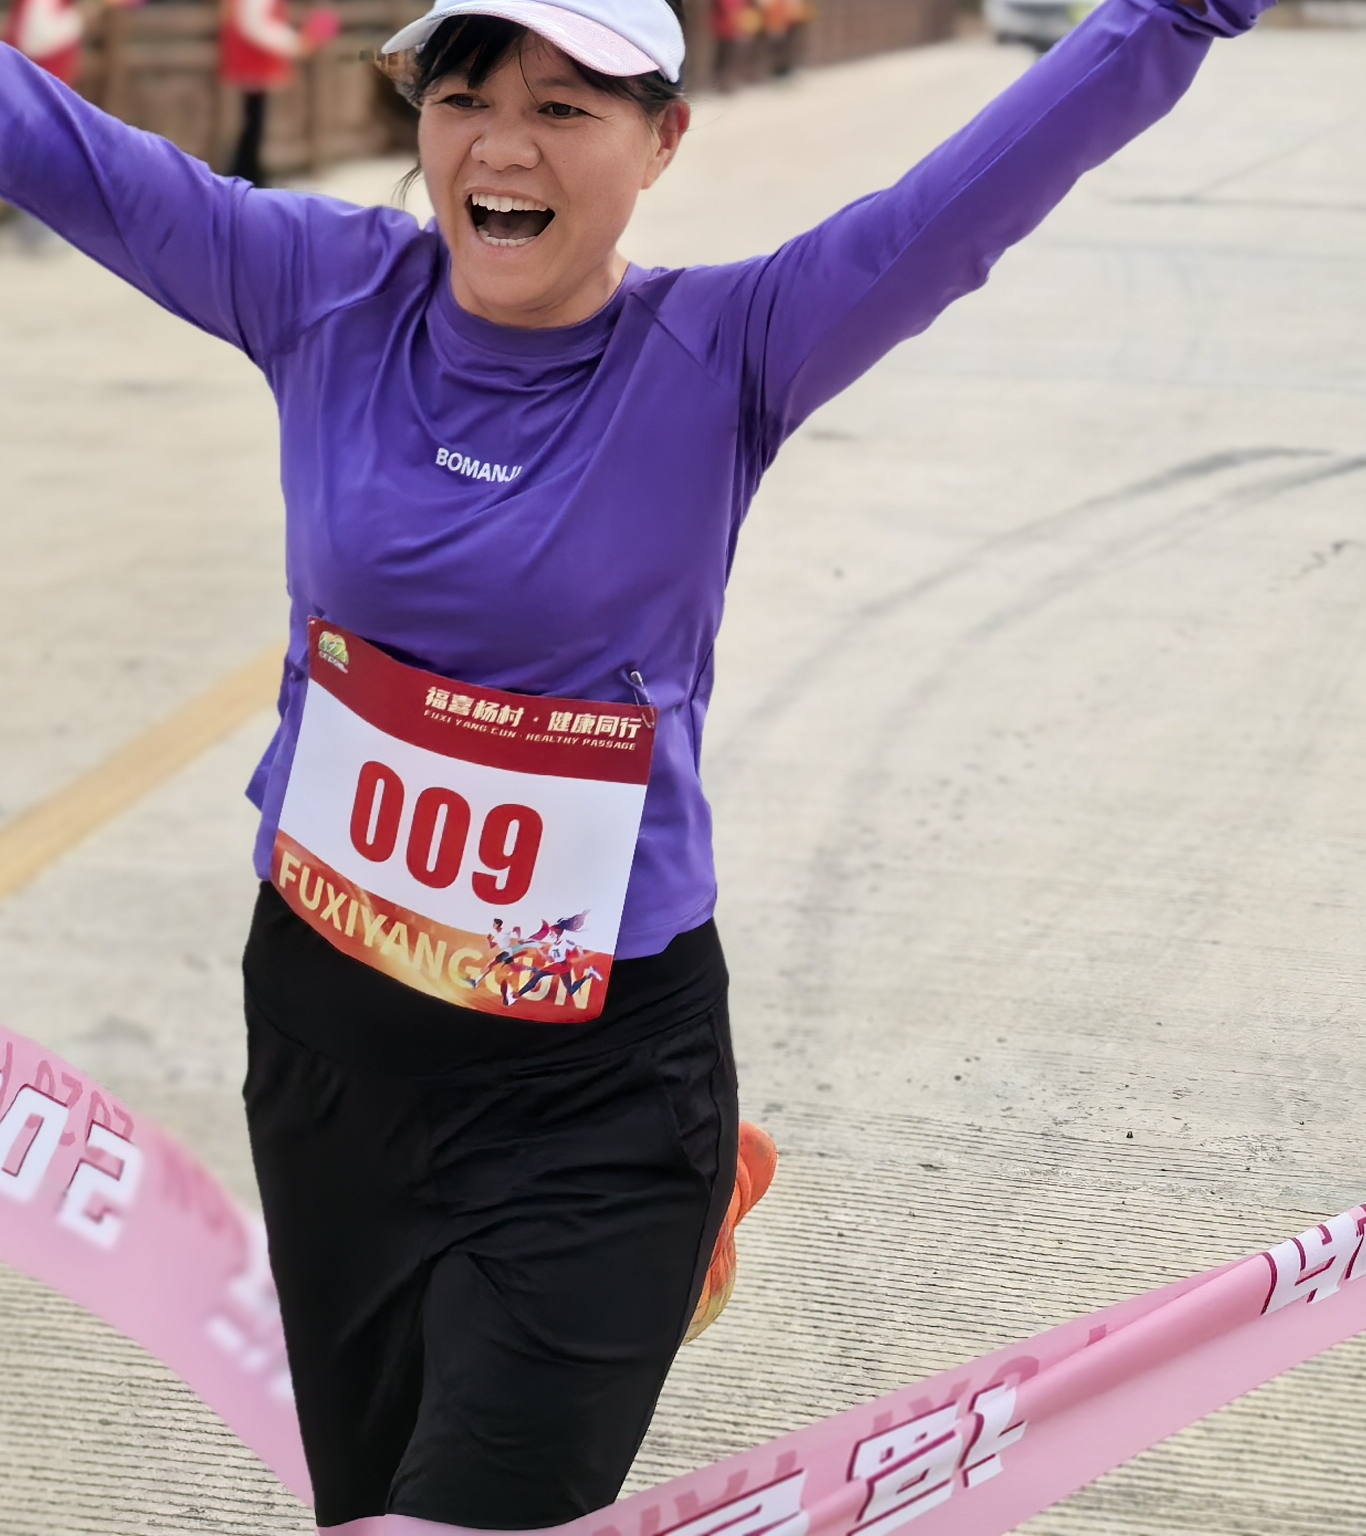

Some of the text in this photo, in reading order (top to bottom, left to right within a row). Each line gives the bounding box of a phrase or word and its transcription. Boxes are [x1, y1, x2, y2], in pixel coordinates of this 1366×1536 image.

[423, 709, 637, 751] FUXI YANG CUN HEALTHY PASSAGE
[424, 686, 642, 739] 福喜杨村 健康同行
[349, 760, 544, 905] 009
